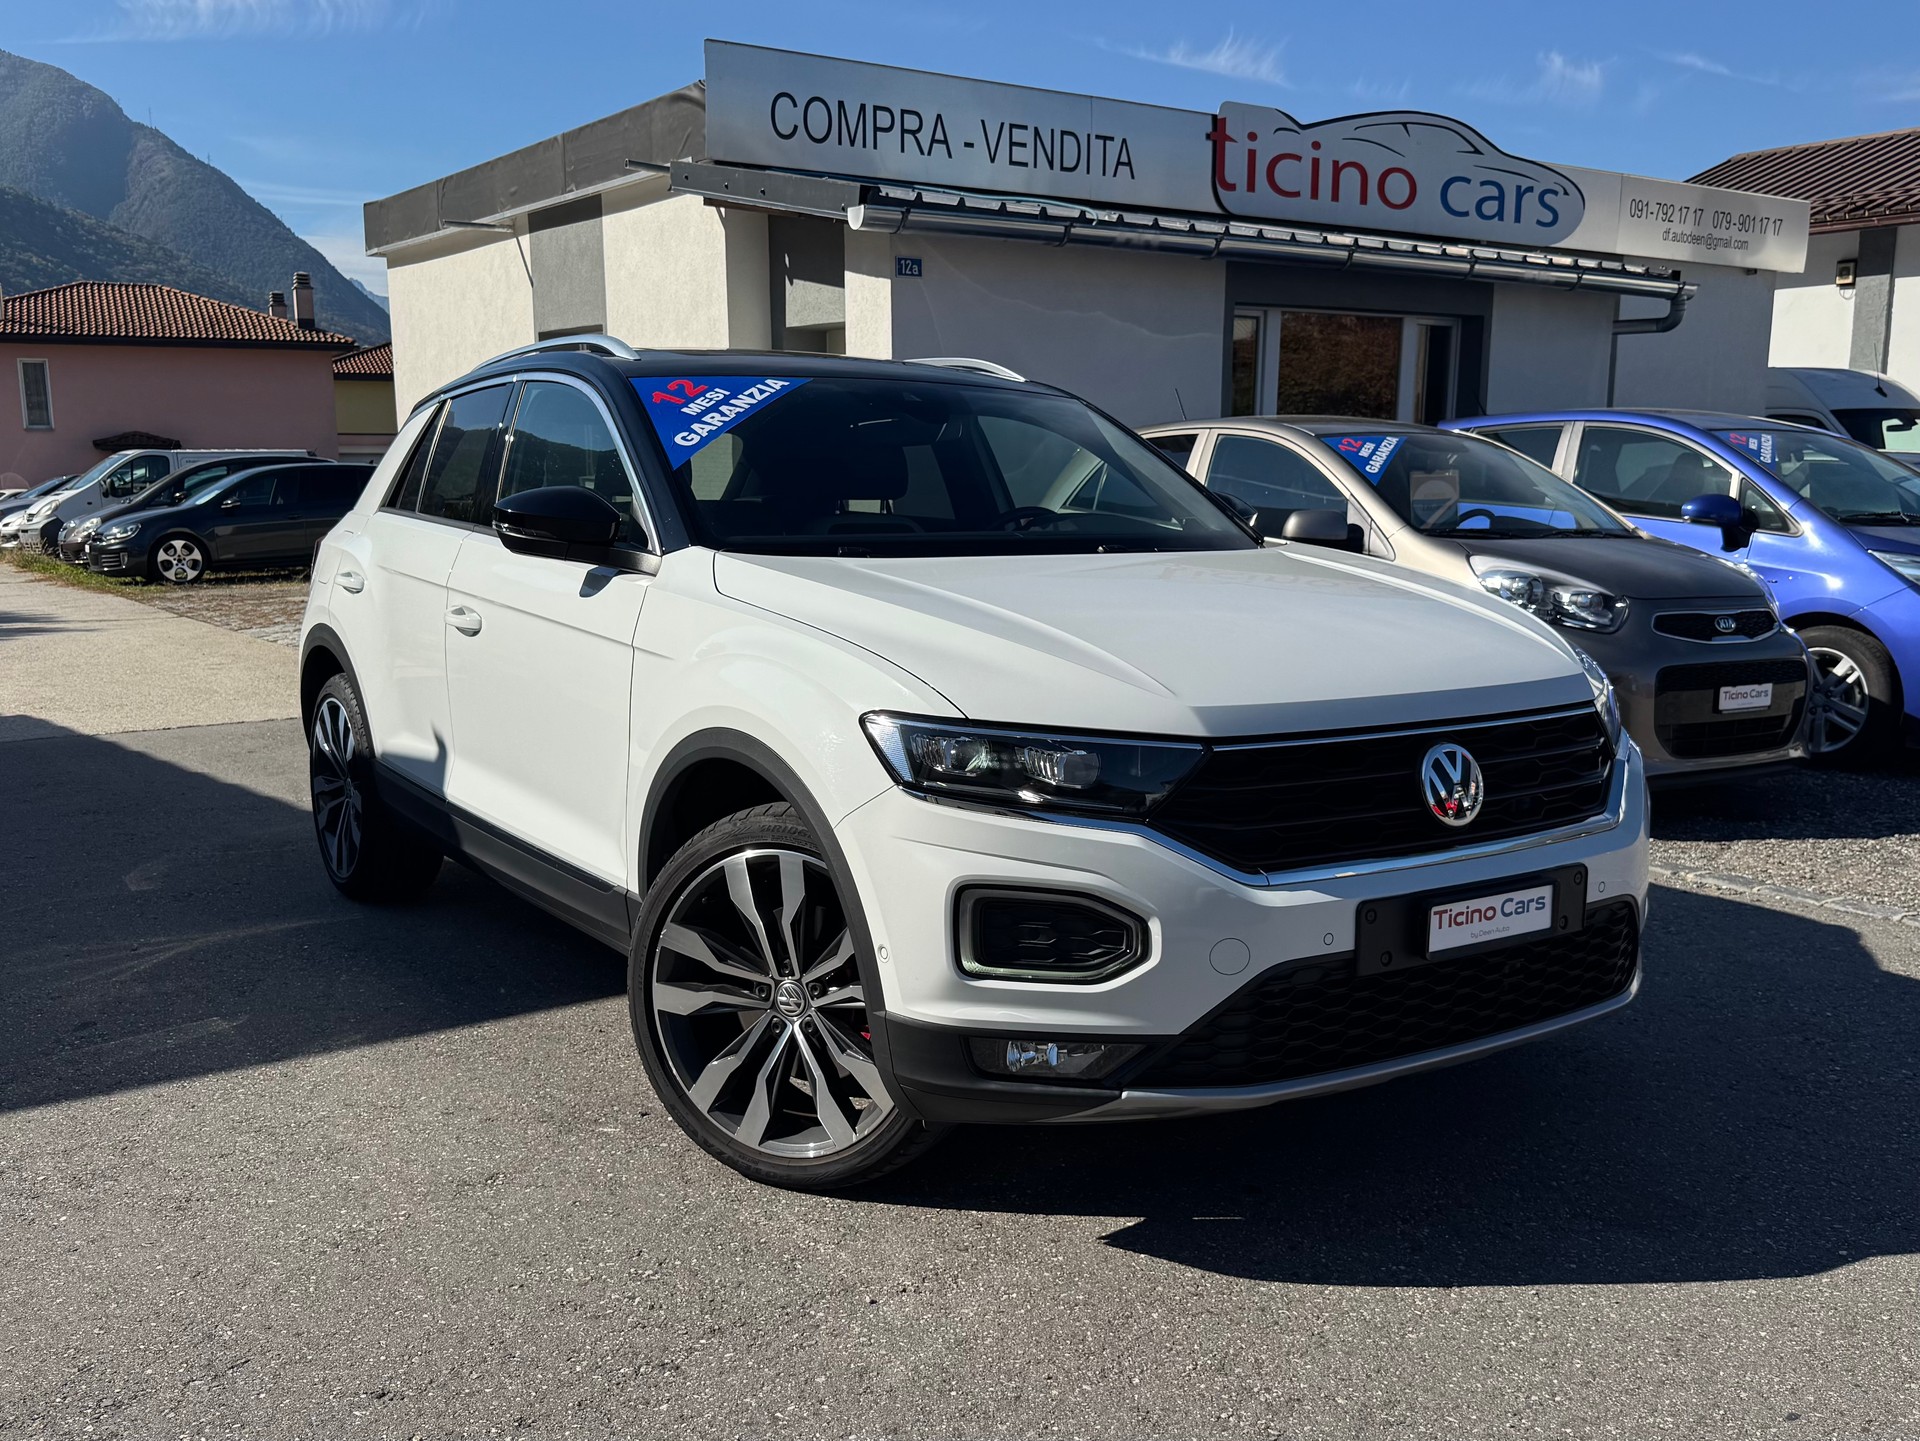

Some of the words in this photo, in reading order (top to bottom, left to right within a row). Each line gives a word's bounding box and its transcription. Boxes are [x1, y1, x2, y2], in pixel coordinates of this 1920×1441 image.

[769, 91, 953, 160] COMPRA
[1210, 117, 1418, 211] ticino
[1440, 175, 1560, 229] cars
[1629, 198, 1675, 223] 091-792
[1678, 206, 1690, 225] 17
[1693, 208, 1704, 227] 17
[1758, 217, 1770, 235] 17
[1772, 218, 1784, 237] 17
[900, 259, 920, 275] 12a
[652, 379, 708, 405] 12
[680, 387, 731, 416] MESI
[674, 378, 790, 447] GARANZIA
[1338, 438, 1363, 453] 12
[1358, 442, 1376, 458] MESI
[1365, 436, 1400, 474] GARANZIA
[1723, 690, 1749, 701] Ticino
[1749, 688, 1769, 699] Cars
[1433, 905, 1497, 930] Ticino
[1500, 896, 1546, 918] Cars
[1470, 931, 1479, 939] by
